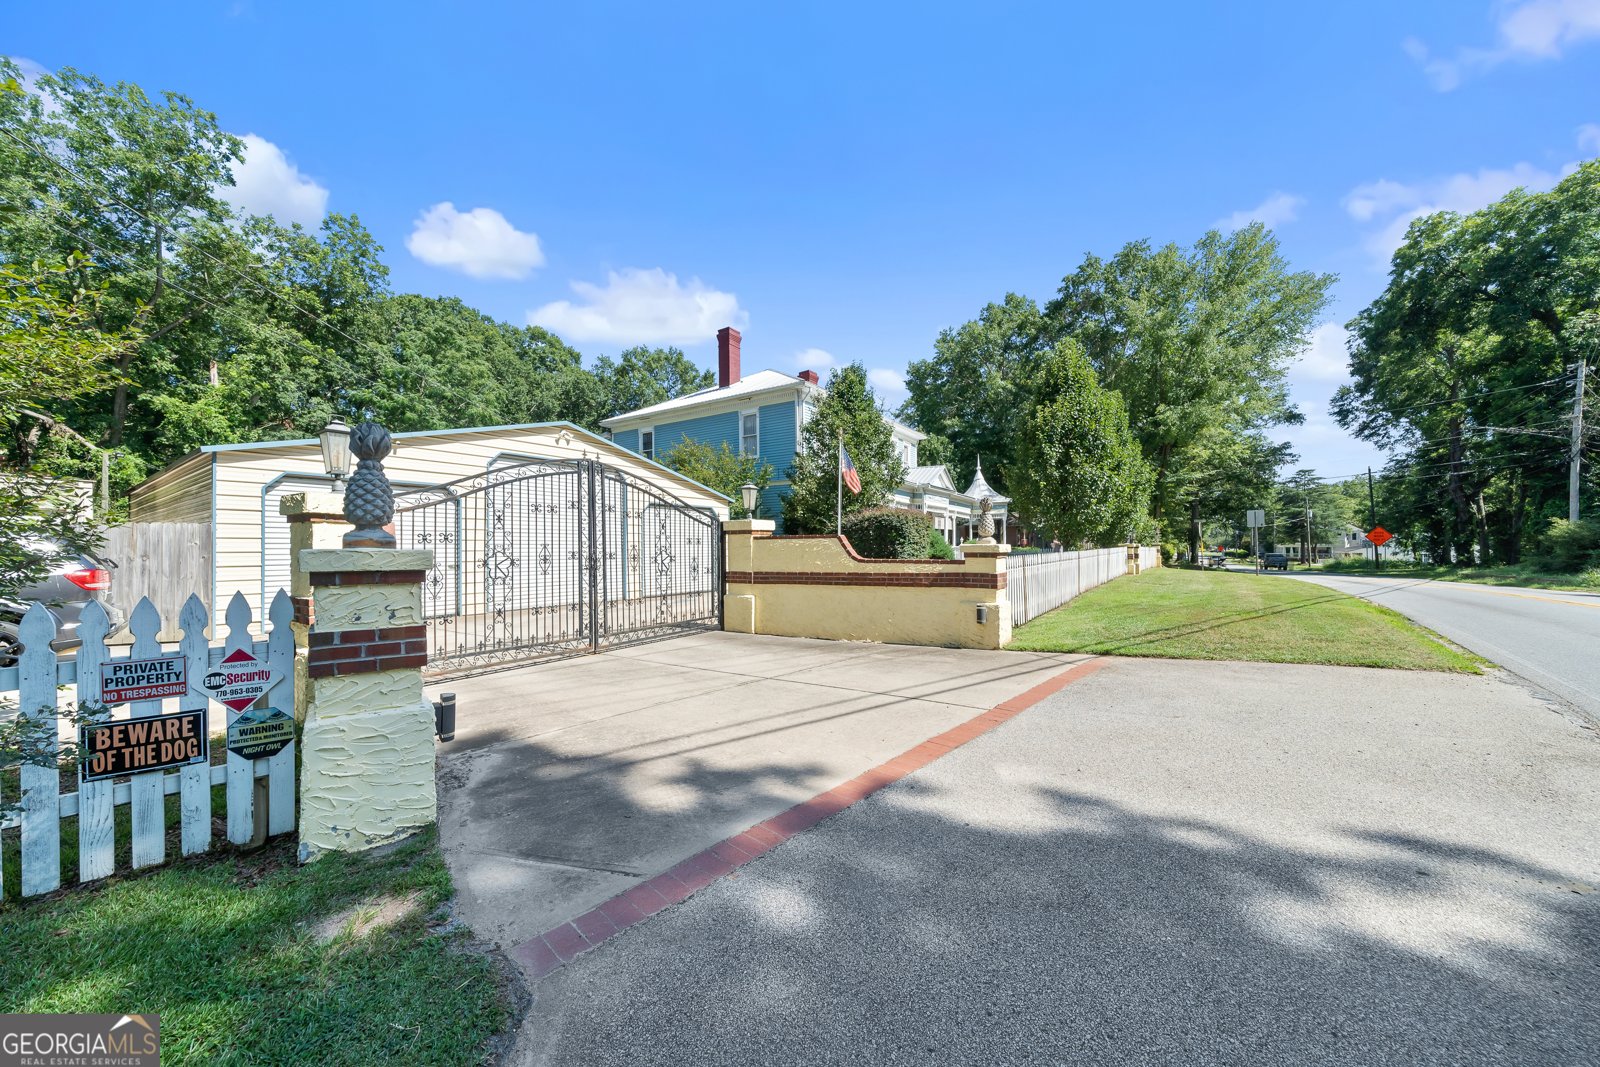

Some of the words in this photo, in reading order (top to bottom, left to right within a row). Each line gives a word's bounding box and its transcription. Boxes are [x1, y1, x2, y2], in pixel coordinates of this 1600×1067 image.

[113, 661, 174, 676] PRIVATE
[219, 662, 249, 670] Protected
[104, 671, 183, 689] PROPERTY
[103, 692, 118, 702] NO
[120, 684, 186, 699] TRESPASSING
[215, 686, 263, 698] 770-963-0305
[95, 716, 194, 750] BEWARE
[239, 722, 285, 737] WARNING
[229, 736, 258, 746] PROTECTED
[263, 731, 293, 741] MONITORED
[92, 750, 117, 773] OF
[121, 744, 157, 769] THE
[161, 737, 198, 763] DOG
[243, 744, 266, 755] NIGHT
[265, 742, 282, 751] OWL
